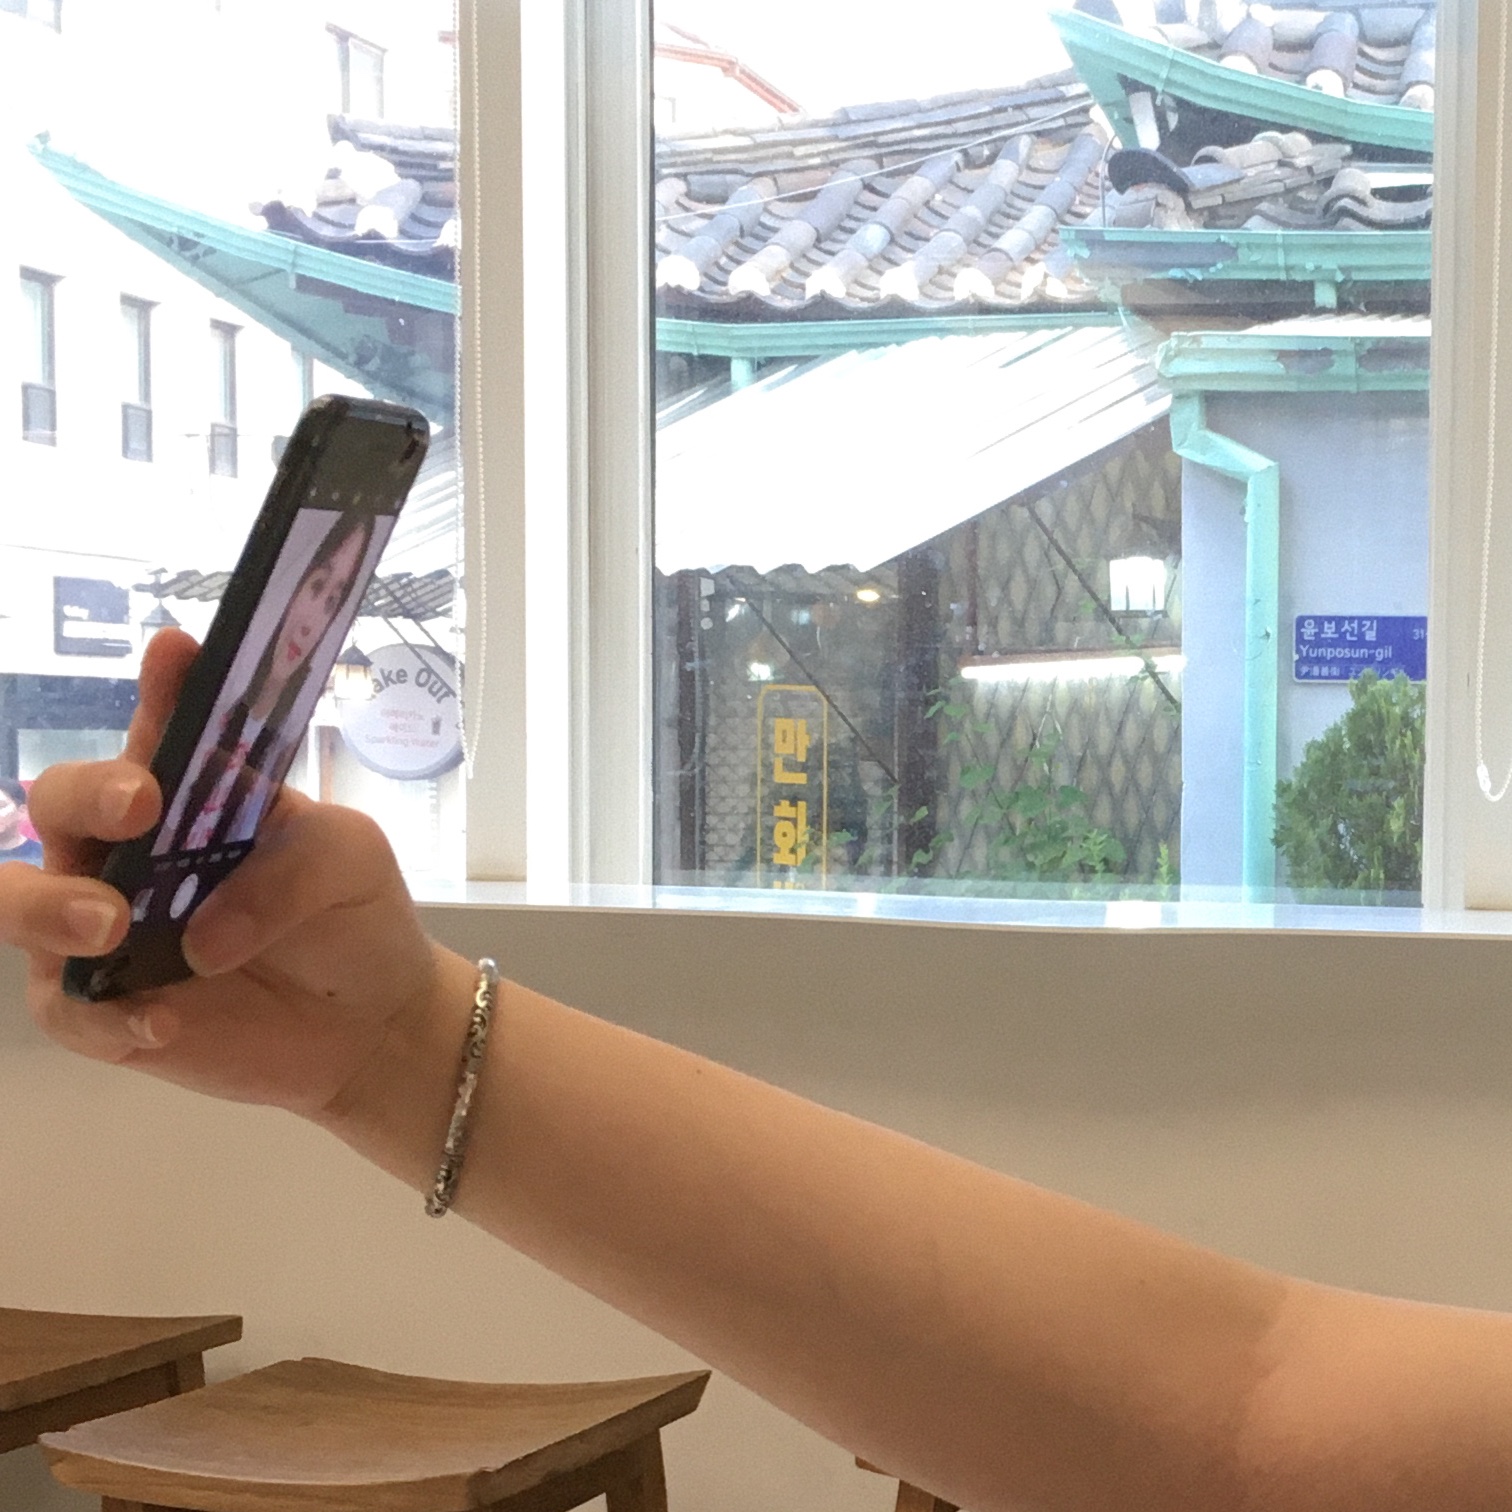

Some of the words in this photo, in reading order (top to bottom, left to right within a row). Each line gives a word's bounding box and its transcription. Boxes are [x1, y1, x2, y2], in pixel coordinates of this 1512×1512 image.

[1300, 618, 1377, 641] 윤보선길
[1300, 644, 1392, 661] Yunposun-gil
[371, 667, 408, 698] ake
[773, 718, 811, 889] 만화
